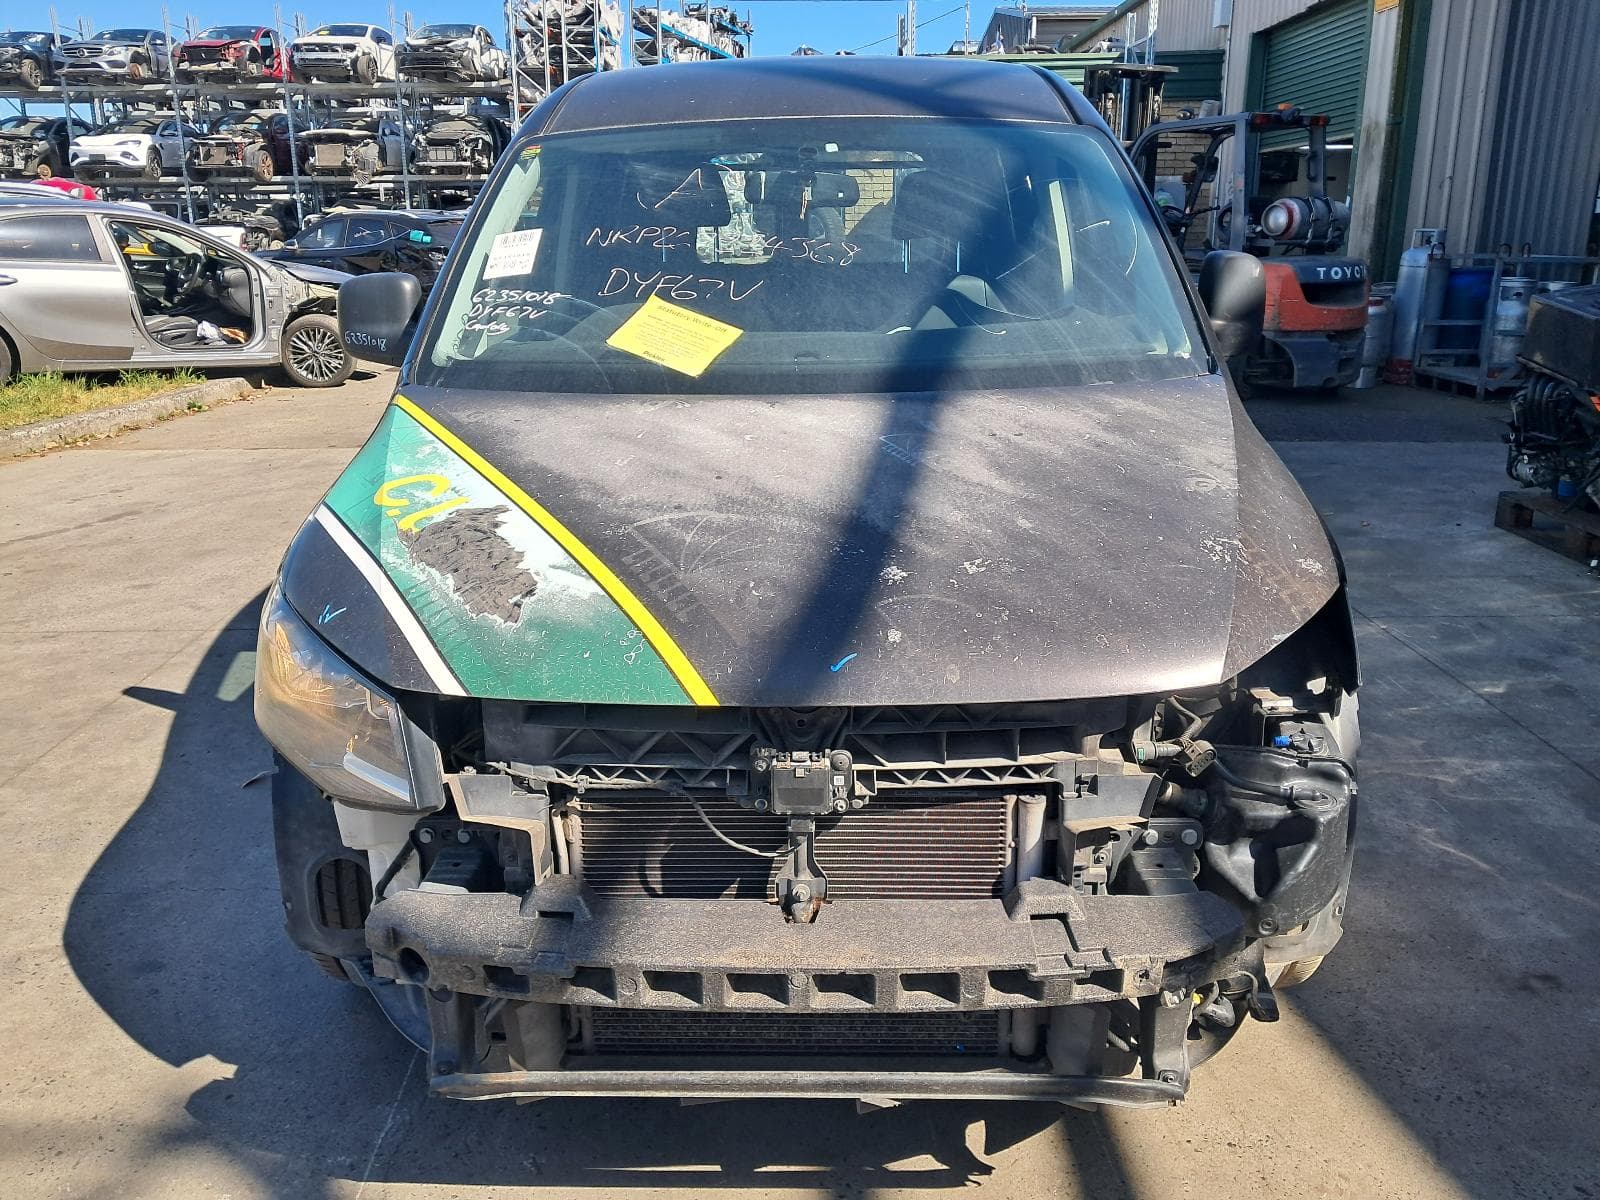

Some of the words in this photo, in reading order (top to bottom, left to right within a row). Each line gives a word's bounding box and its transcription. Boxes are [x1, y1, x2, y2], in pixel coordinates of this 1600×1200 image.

[1316, 265, 1367, 280] TOYO
[472, 288, 562, 305] 62351018
[344, 330, 387, 352] 62351018
